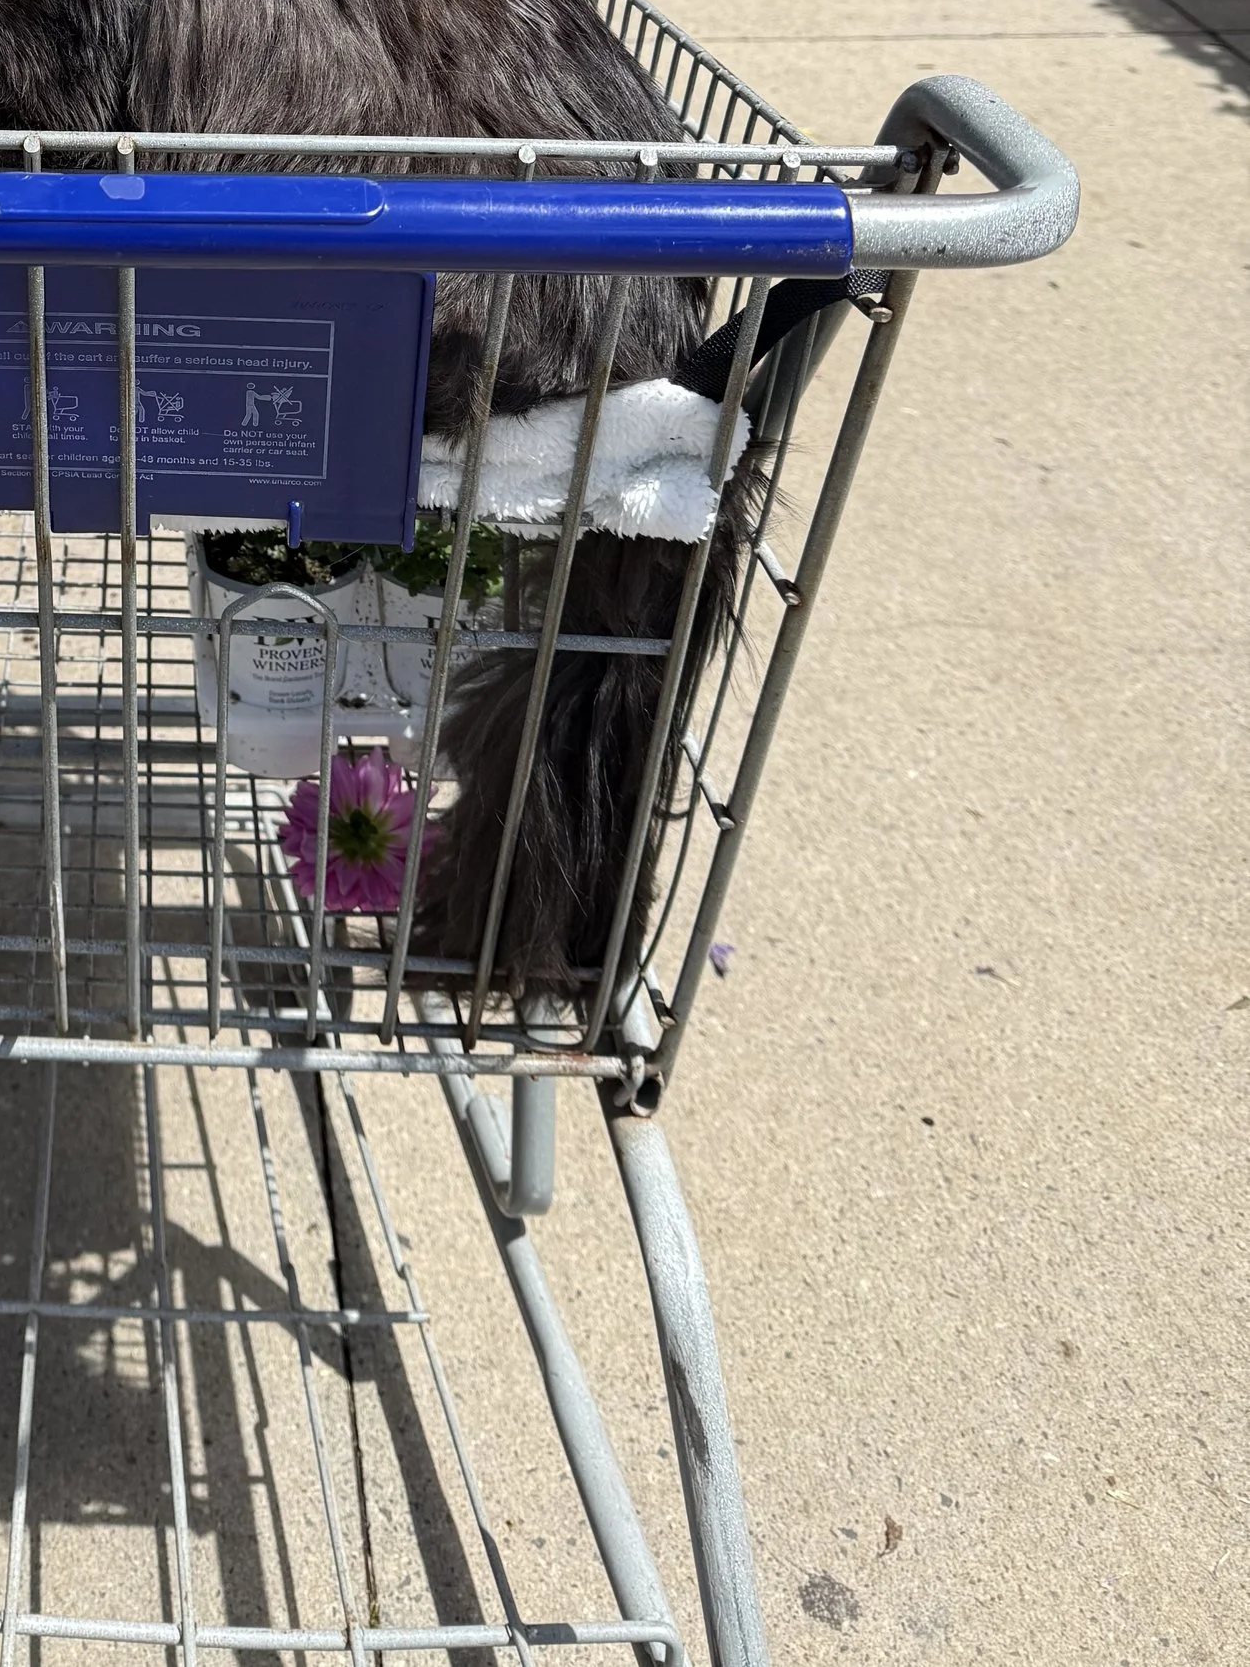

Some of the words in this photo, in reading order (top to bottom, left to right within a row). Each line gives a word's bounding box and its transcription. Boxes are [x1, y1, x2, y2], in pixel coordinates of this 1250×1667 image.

[45, 321, 201, 337] WARING
[13, 352, 30, 361] ou
[54, 351, 75, 361] the
[78, 352, 103, 363] cart
[173, 355, 182, 364] a
[185, 355, 233, 366] serious
[237, 356, 269, 367] head
[272, 357, 314, 370] injury.
[12, 423, 32, 431] STA
[63, 425, 84, 434] your
[135, 426, 149, 434] OT
[151, 427, 175, 435] allow
[177, 427, 199, 436] child
[61, 432, 89, 440] times.
[152, 435, 186, 443] basket.
[223, 429, 238, 437] Do
[240, 430, 264, 438] NOT
[265, 431, 283, 439] use
[285, 432, 307, 441] your
[223, 438, 243, 446] own
[245, 438, 287, 448] personal
[290, 440, 316, 448] infant
[223, 446, 254, 454] carrier
[256, 447, 266, 455] or
[285, 448, 309, 456] seat.
[57, 453, 99, 462] children
[156, 456, 195, 465] months
[199, 457, 219, 466] and
[222, 458, 252, 467] 15-35
[255, 458, 274, 468] lbs.
[1, 469, 32, 477] Section
[139, 473, 154, 481] Act
[248, 478, 322, 487] www.unarco.com
[259, 645, 323, 660] PROVEN
[252, 656, 326, 672] WINNERS
